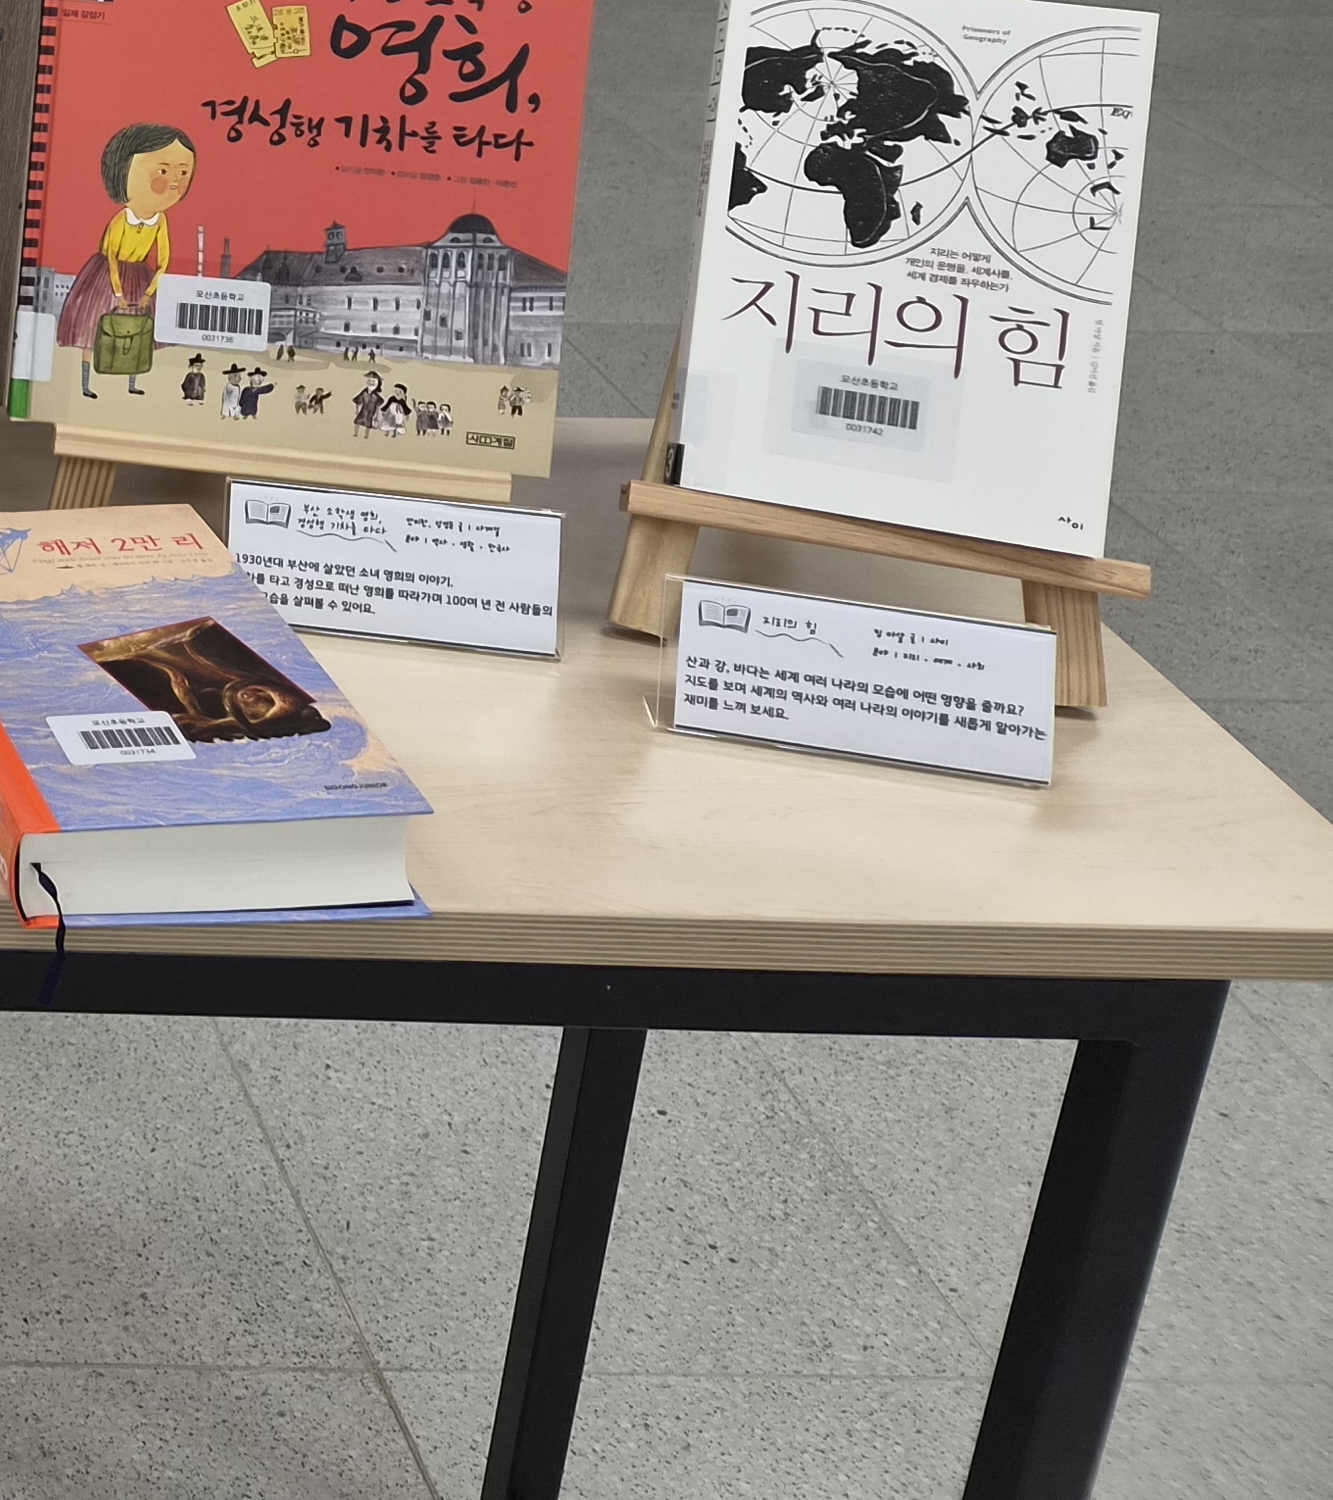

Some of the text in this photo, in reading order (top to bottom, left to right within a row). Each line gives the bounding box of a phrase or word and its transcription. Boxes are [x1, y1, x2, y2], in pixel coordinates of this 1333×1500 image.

[330, 13, 541, 114] 영희,
[201, 96, 534, 162] 경성행 기차를 타다
[721, 270, 970, 379] 지리의
[989, 306, 1070, 389] 힘
[37, 533, 204, 556] 해저 2만 리
[734, 661, 909, 700] 바다는 세계 여러 나라의 모습에
